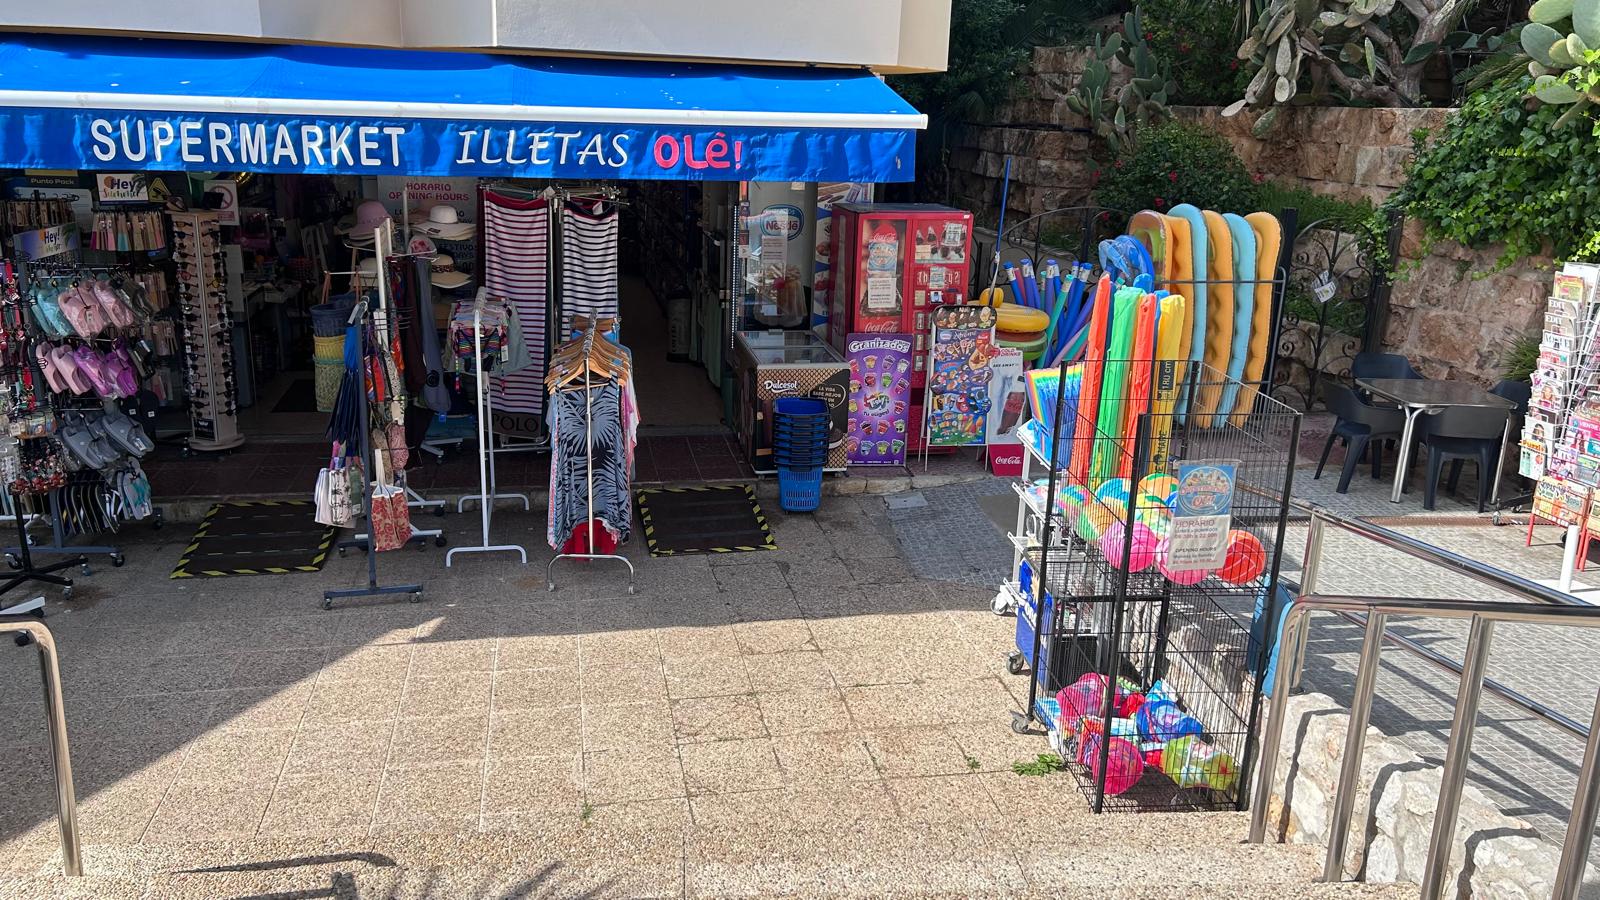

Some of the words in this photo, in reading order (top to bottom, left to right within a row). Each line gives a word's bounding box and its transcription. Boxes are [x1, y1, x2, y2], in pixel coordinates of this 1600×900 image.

[90, 118, 405, 167] SUPERMARKET
[456, 128, 629, 168] ILLETAS
[111, 179, 136, 191] Hey
[406, 183, 451, 191] HORARIO
[389, 192, 433, 201] OPNING
[436, 193, 470, 201] HOURS
[849, 338, 911, 353] Granizados
[764, 380, 798, 390] Dulcesol
